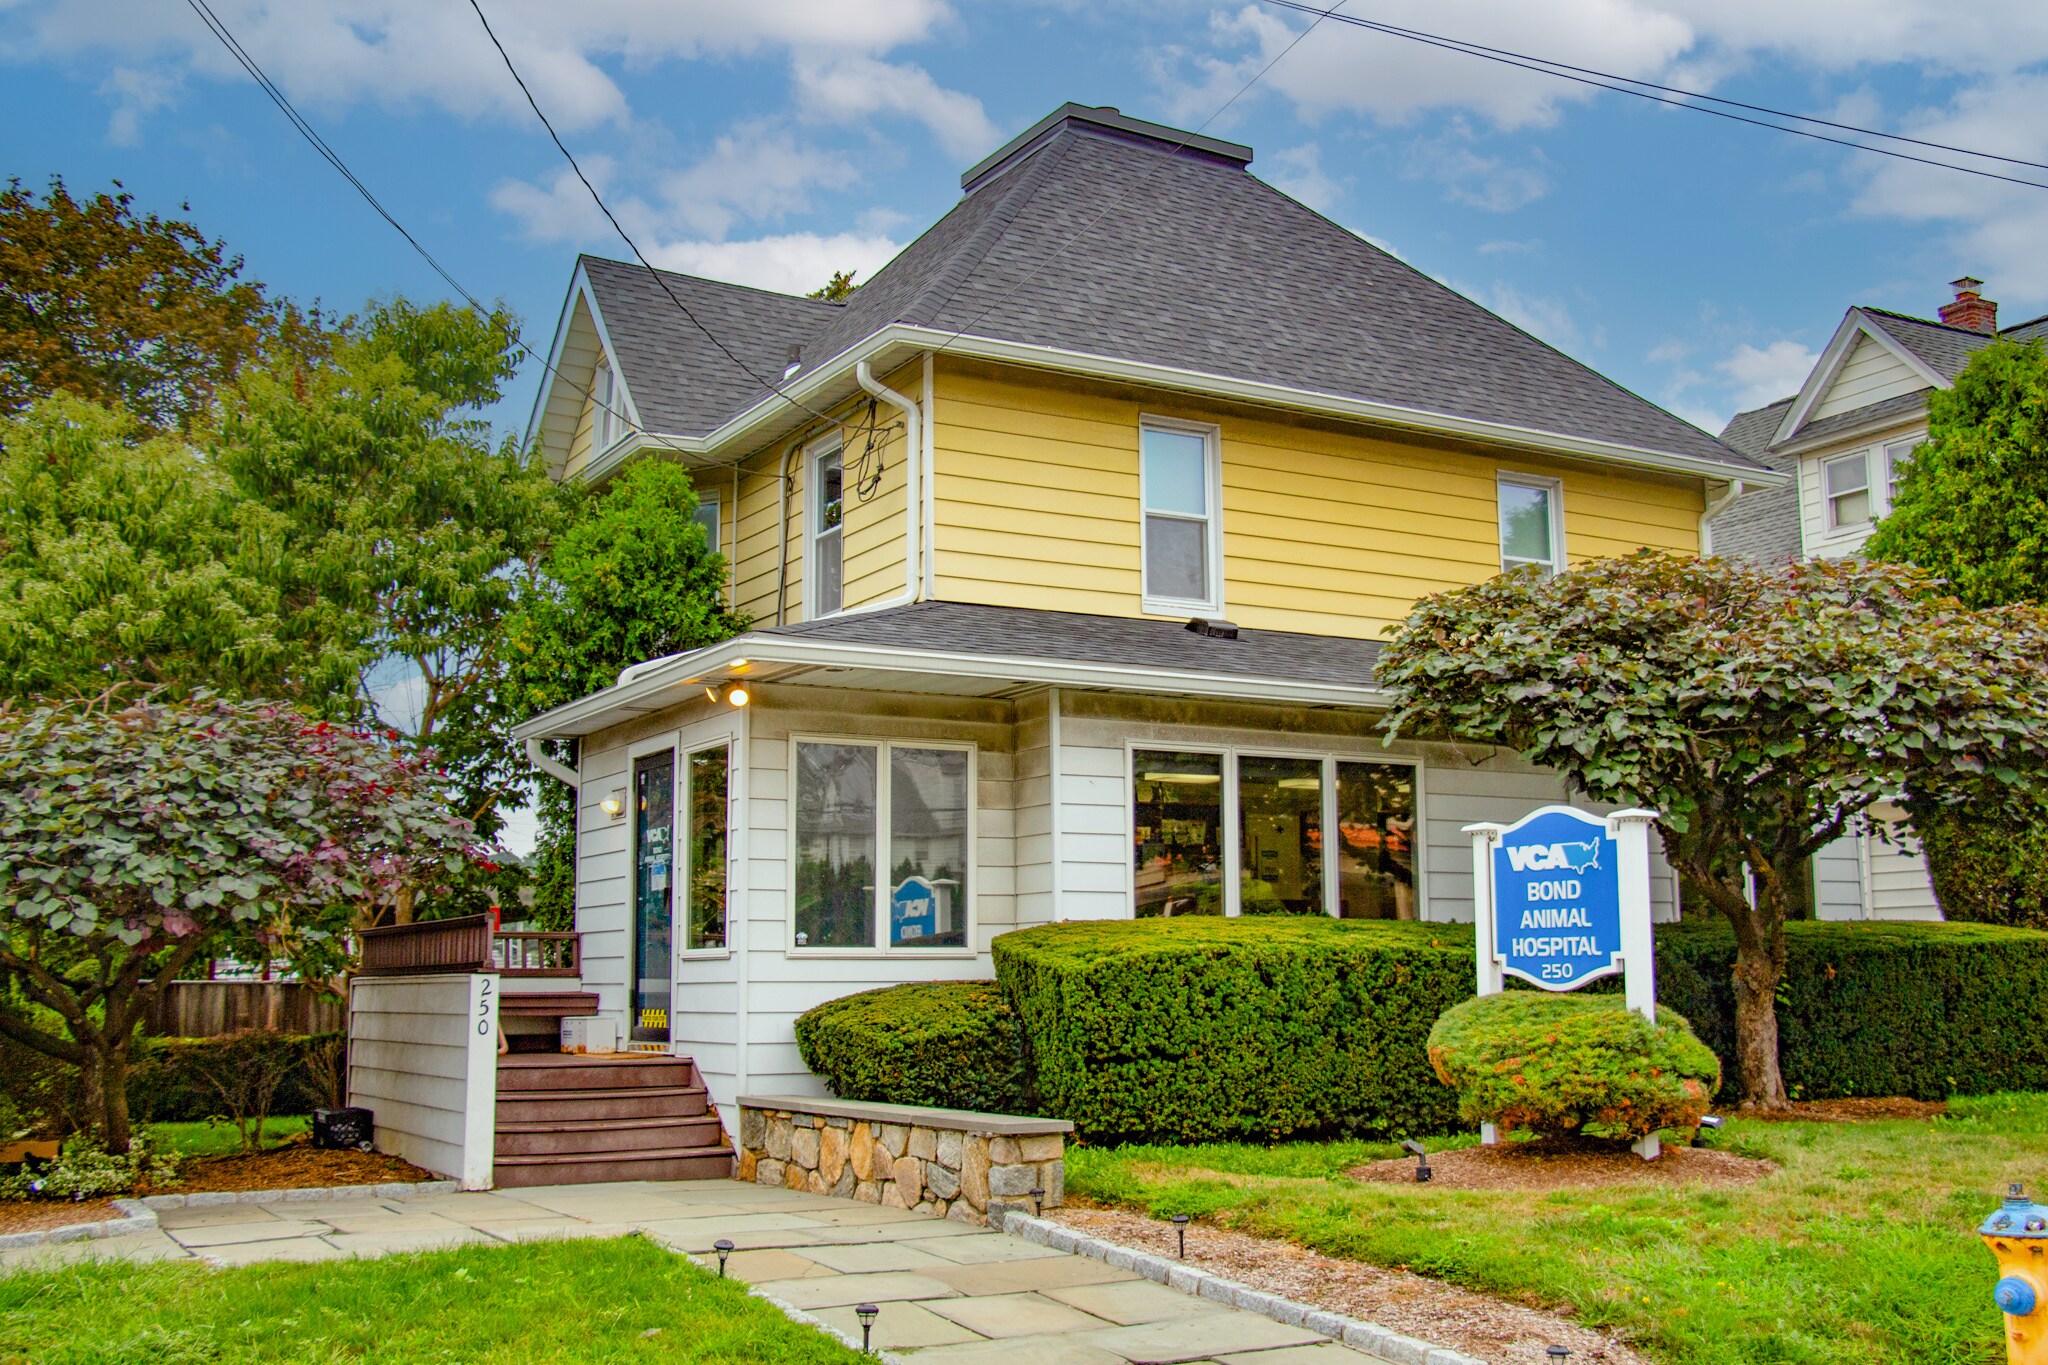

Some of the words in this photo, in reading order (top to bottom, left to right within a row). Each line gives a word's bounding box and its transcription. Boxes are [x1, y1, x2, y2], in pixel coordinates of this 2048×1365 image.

[1506, 844, 1569, 872] VCA
[1527, 880, 1581, 901] BOND
[1520, 908, 1592, 929] ANIMAL
[1512, 936, 1602, 957] HOSPITAL
[1541, 963, 1573, 979] 250
[478, 979, 492, 1035] 250
